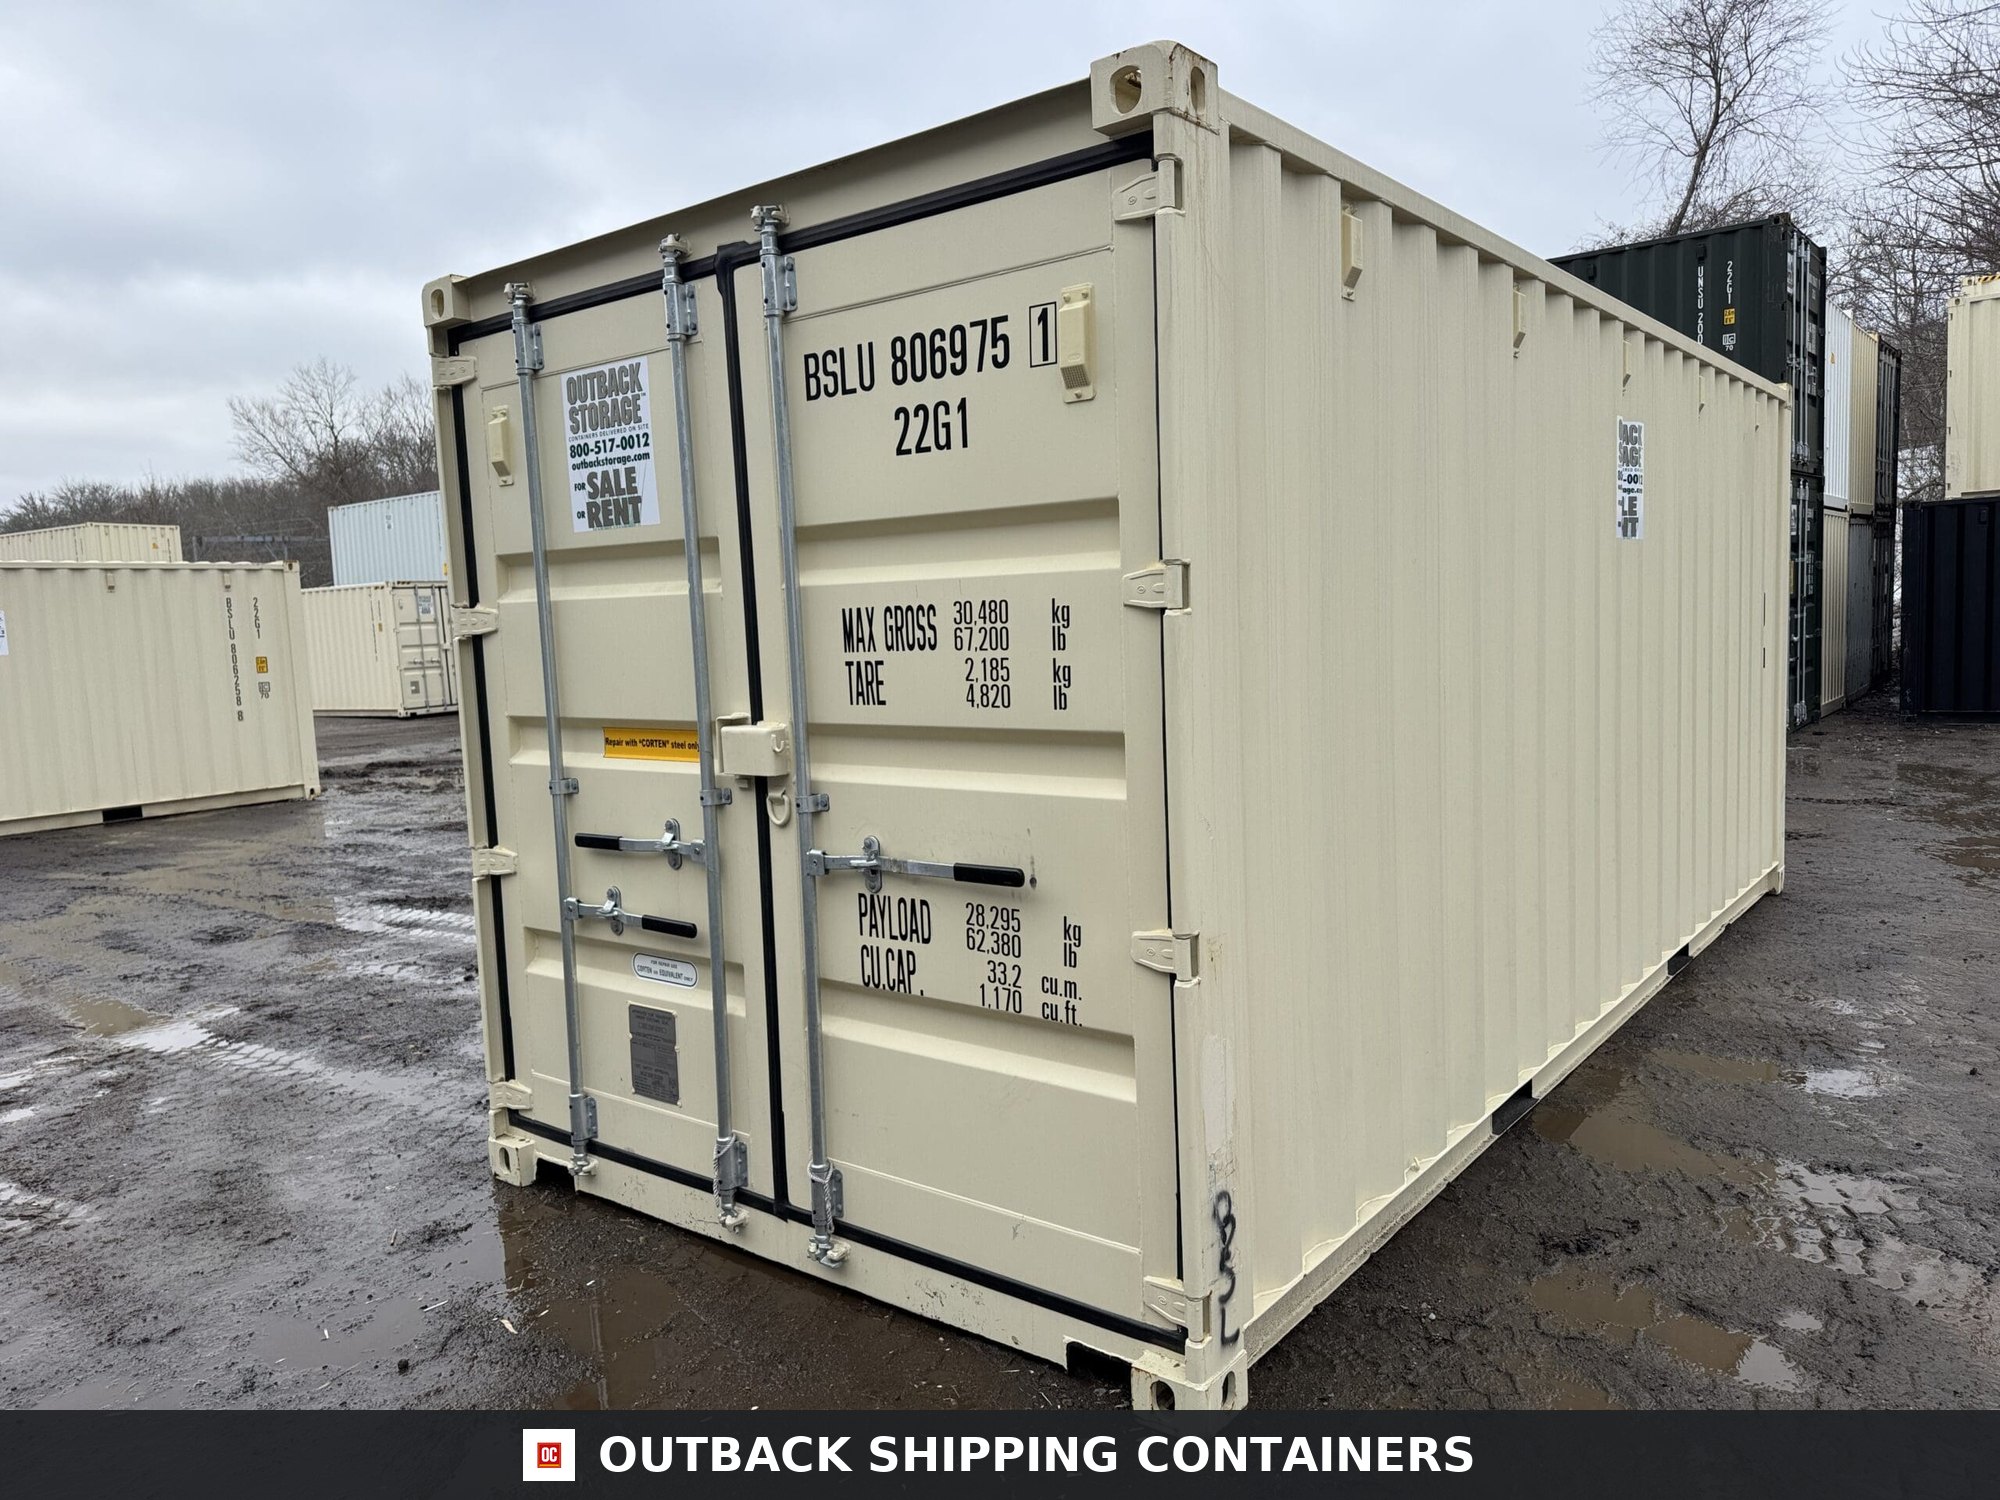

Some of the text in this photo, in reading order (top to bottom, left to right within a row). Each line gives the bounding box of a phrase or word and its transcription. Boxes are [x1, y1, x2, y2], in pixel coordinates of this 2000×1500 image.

[804, 341, 875, 401] BSLU
[890, 315, 1010, 386] 806975
[566, 362, 643, 405] OUTBACK
[568, 394, 643, 435] STORAGE
[894, 397, 968, 456] 22G1
[569, 432, 598, 443] CONTAINERS
[600, 427, 627, 438] DELIVERED
[570, 432, 650, 459] 800-517-0012
[572, 452, 650, 471] outbackstorage.com
[574, 466, 638, 500] FOR SALE
[576, 496, 642, 528] OR RENT
[842, 598, 1070, 653] MAX GROSS 30,480 kg
[954, 626, 1067, 652] 67,200 lb
[226, 597, 244, 721] BSLU 806258 8
[845, 657, 1071, 706] TARE 2,185 kg
[966, 684, 1068, 710] 4,820 lb
[605, 737, 623, 748] Repair
[625, 738, 637, 747] with
[671, 741, 686, 750] steel
[687, 742, 700, 752] only
[858, 893, 1082, 947] PAYLOAD 28,295 kg
[966, 928, 1077, 968] 62,380 lb
[987, 960, 1022, 989] 33.2
[1041, 976, 1082, 1000] cu.m.
[980, 983, 1082, 1027] 1,170 cu.ft.
